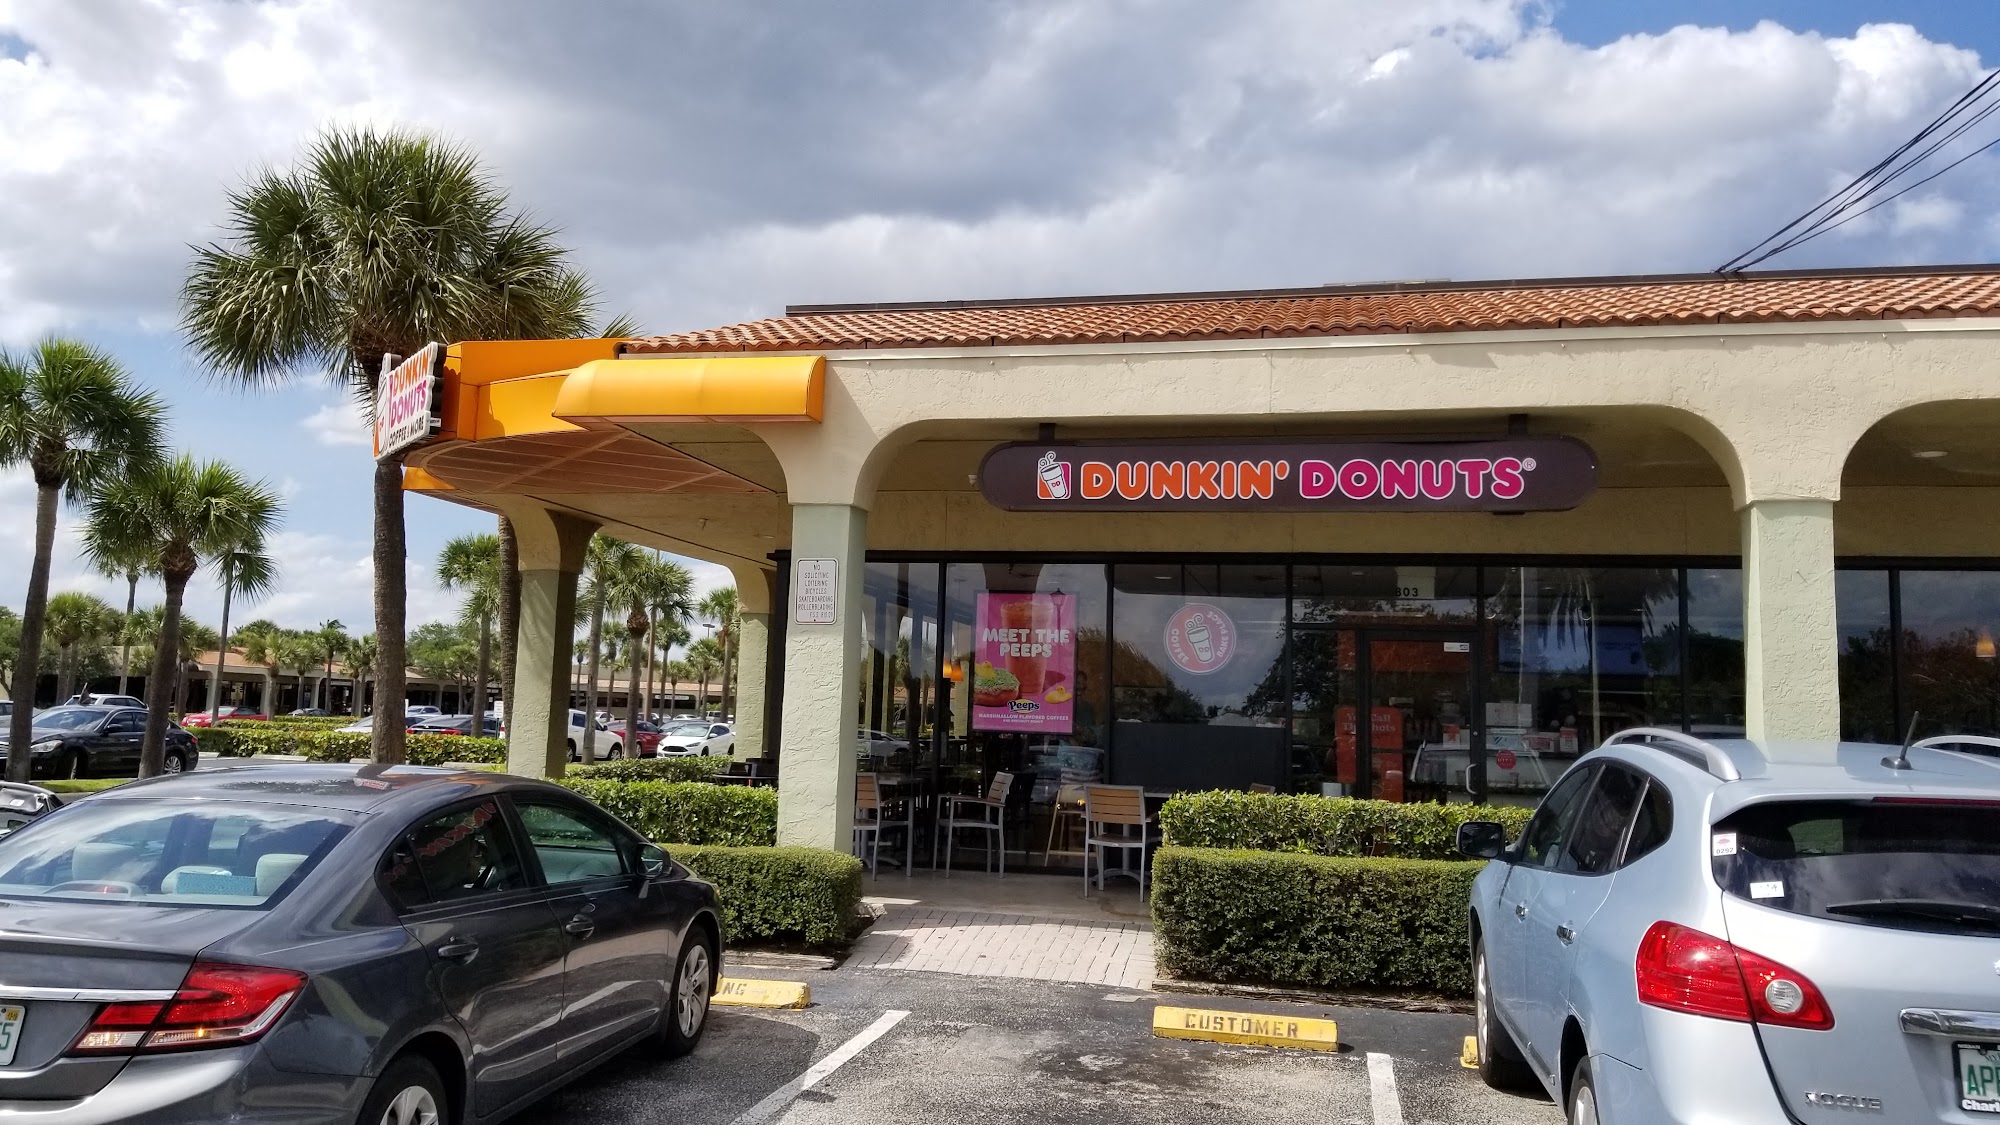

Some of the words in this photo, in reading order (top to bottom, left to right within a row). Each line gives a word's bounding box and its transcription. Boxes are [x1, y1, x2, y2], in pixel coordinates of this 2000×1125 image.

[390, 379, 427, 429] DONUTS
[388, 425, 407, 447] COFFEE
[410, 417, 424, 436] MORE
[1081, 460, 1290, 500] DUNKIN'
[804, 579, 828, 587] LOITERING
[805, 587, 827, 595] BICYCLES
[798, 595, 834, 603] SKATEBOARDING
[797, 603, 834, 611] ROLLERBLADING
[982, 628, 1031, 643] MEET
[1035, 628, 1070, 643] THE
[1000, 643, 1052, 658] PEEPS
[1171, 628, 1190, 664] COFFEE
[1216, 635, 1229, 658] BAKE
[1007, 701, 1040, 712] Peeps
[1371, 723, 1396, 732] hots
[1185, 1013, 1299, 1039] CUSTOMER
[1804, 1090, 1881, 1109] ROGUE
